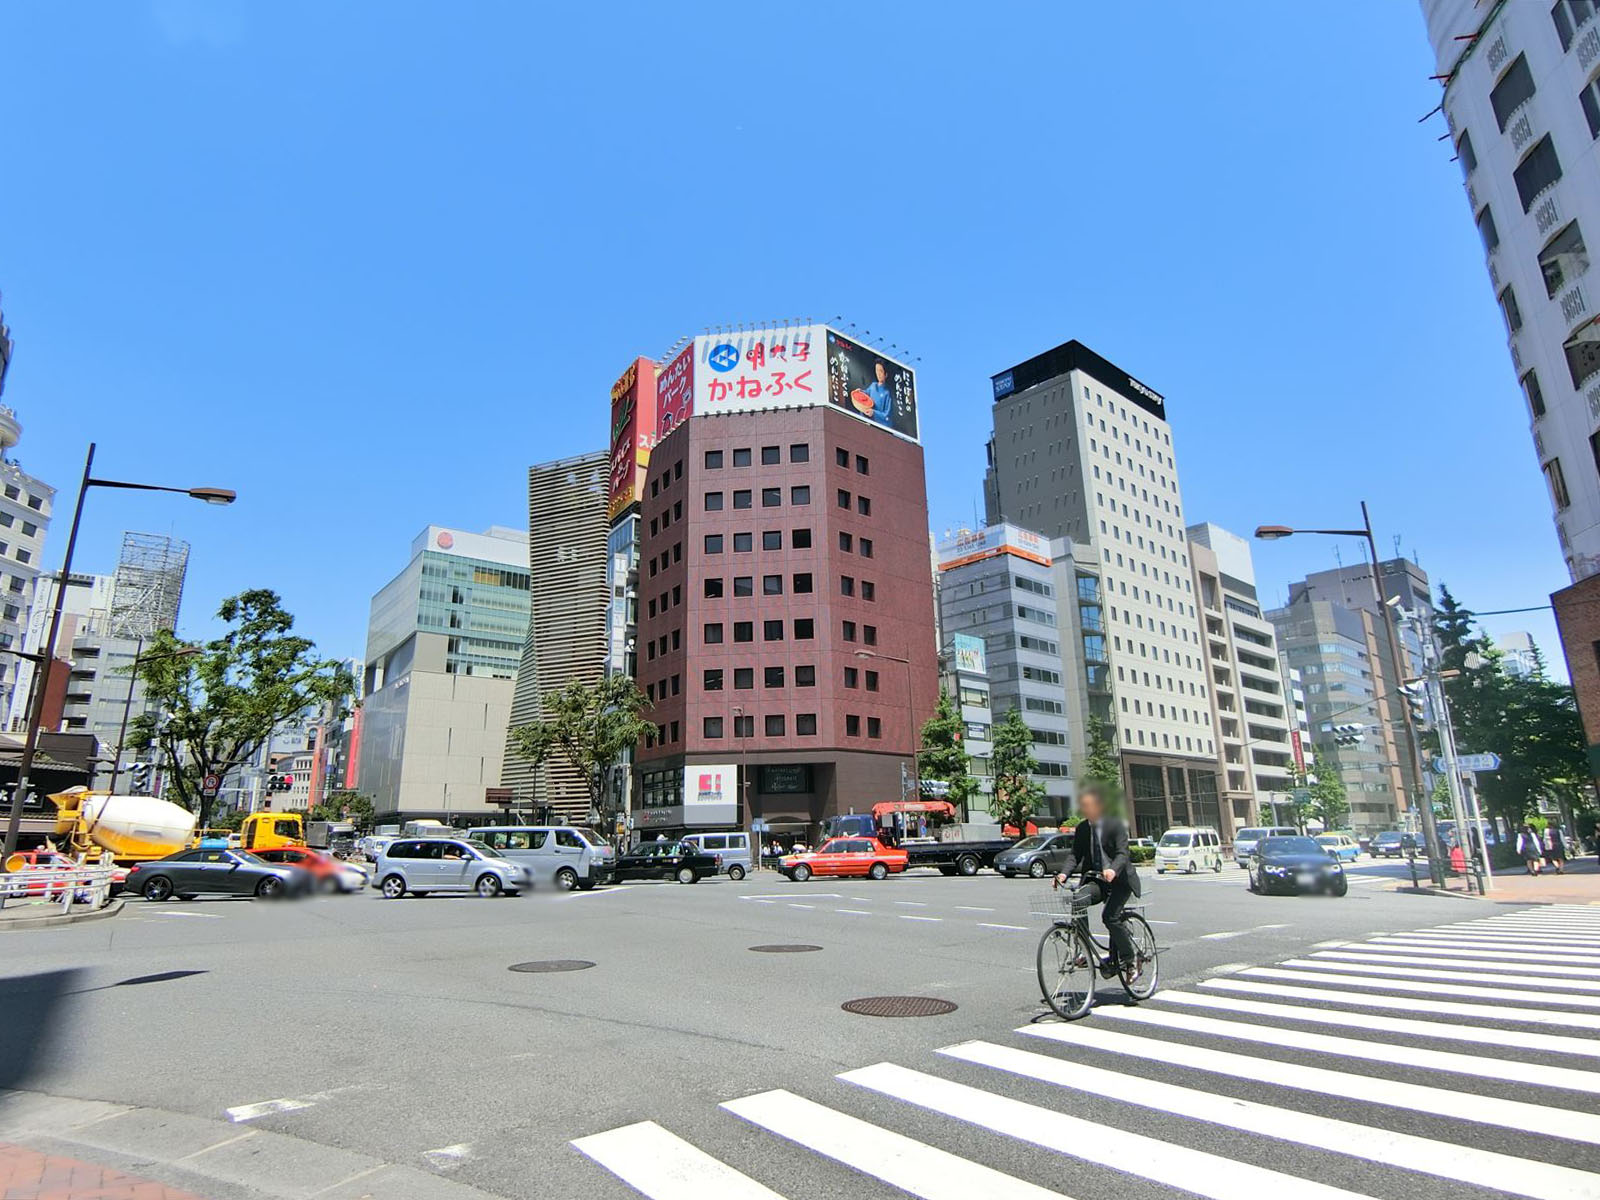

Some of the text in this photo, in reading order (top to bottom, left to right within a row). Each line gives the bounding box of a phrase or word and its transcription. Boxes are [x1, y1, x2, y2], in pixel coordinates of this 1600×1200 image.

[659, 354, 691, 394] めんたい
[663, 376, 687, 408] パーク
[708, 370, 813, 401] かねふく
[829, 356, 839, 402] めんたいこ
[838, 351, 850, 398] かねふくの
[894, 374, 903, 416] めんたいこ
